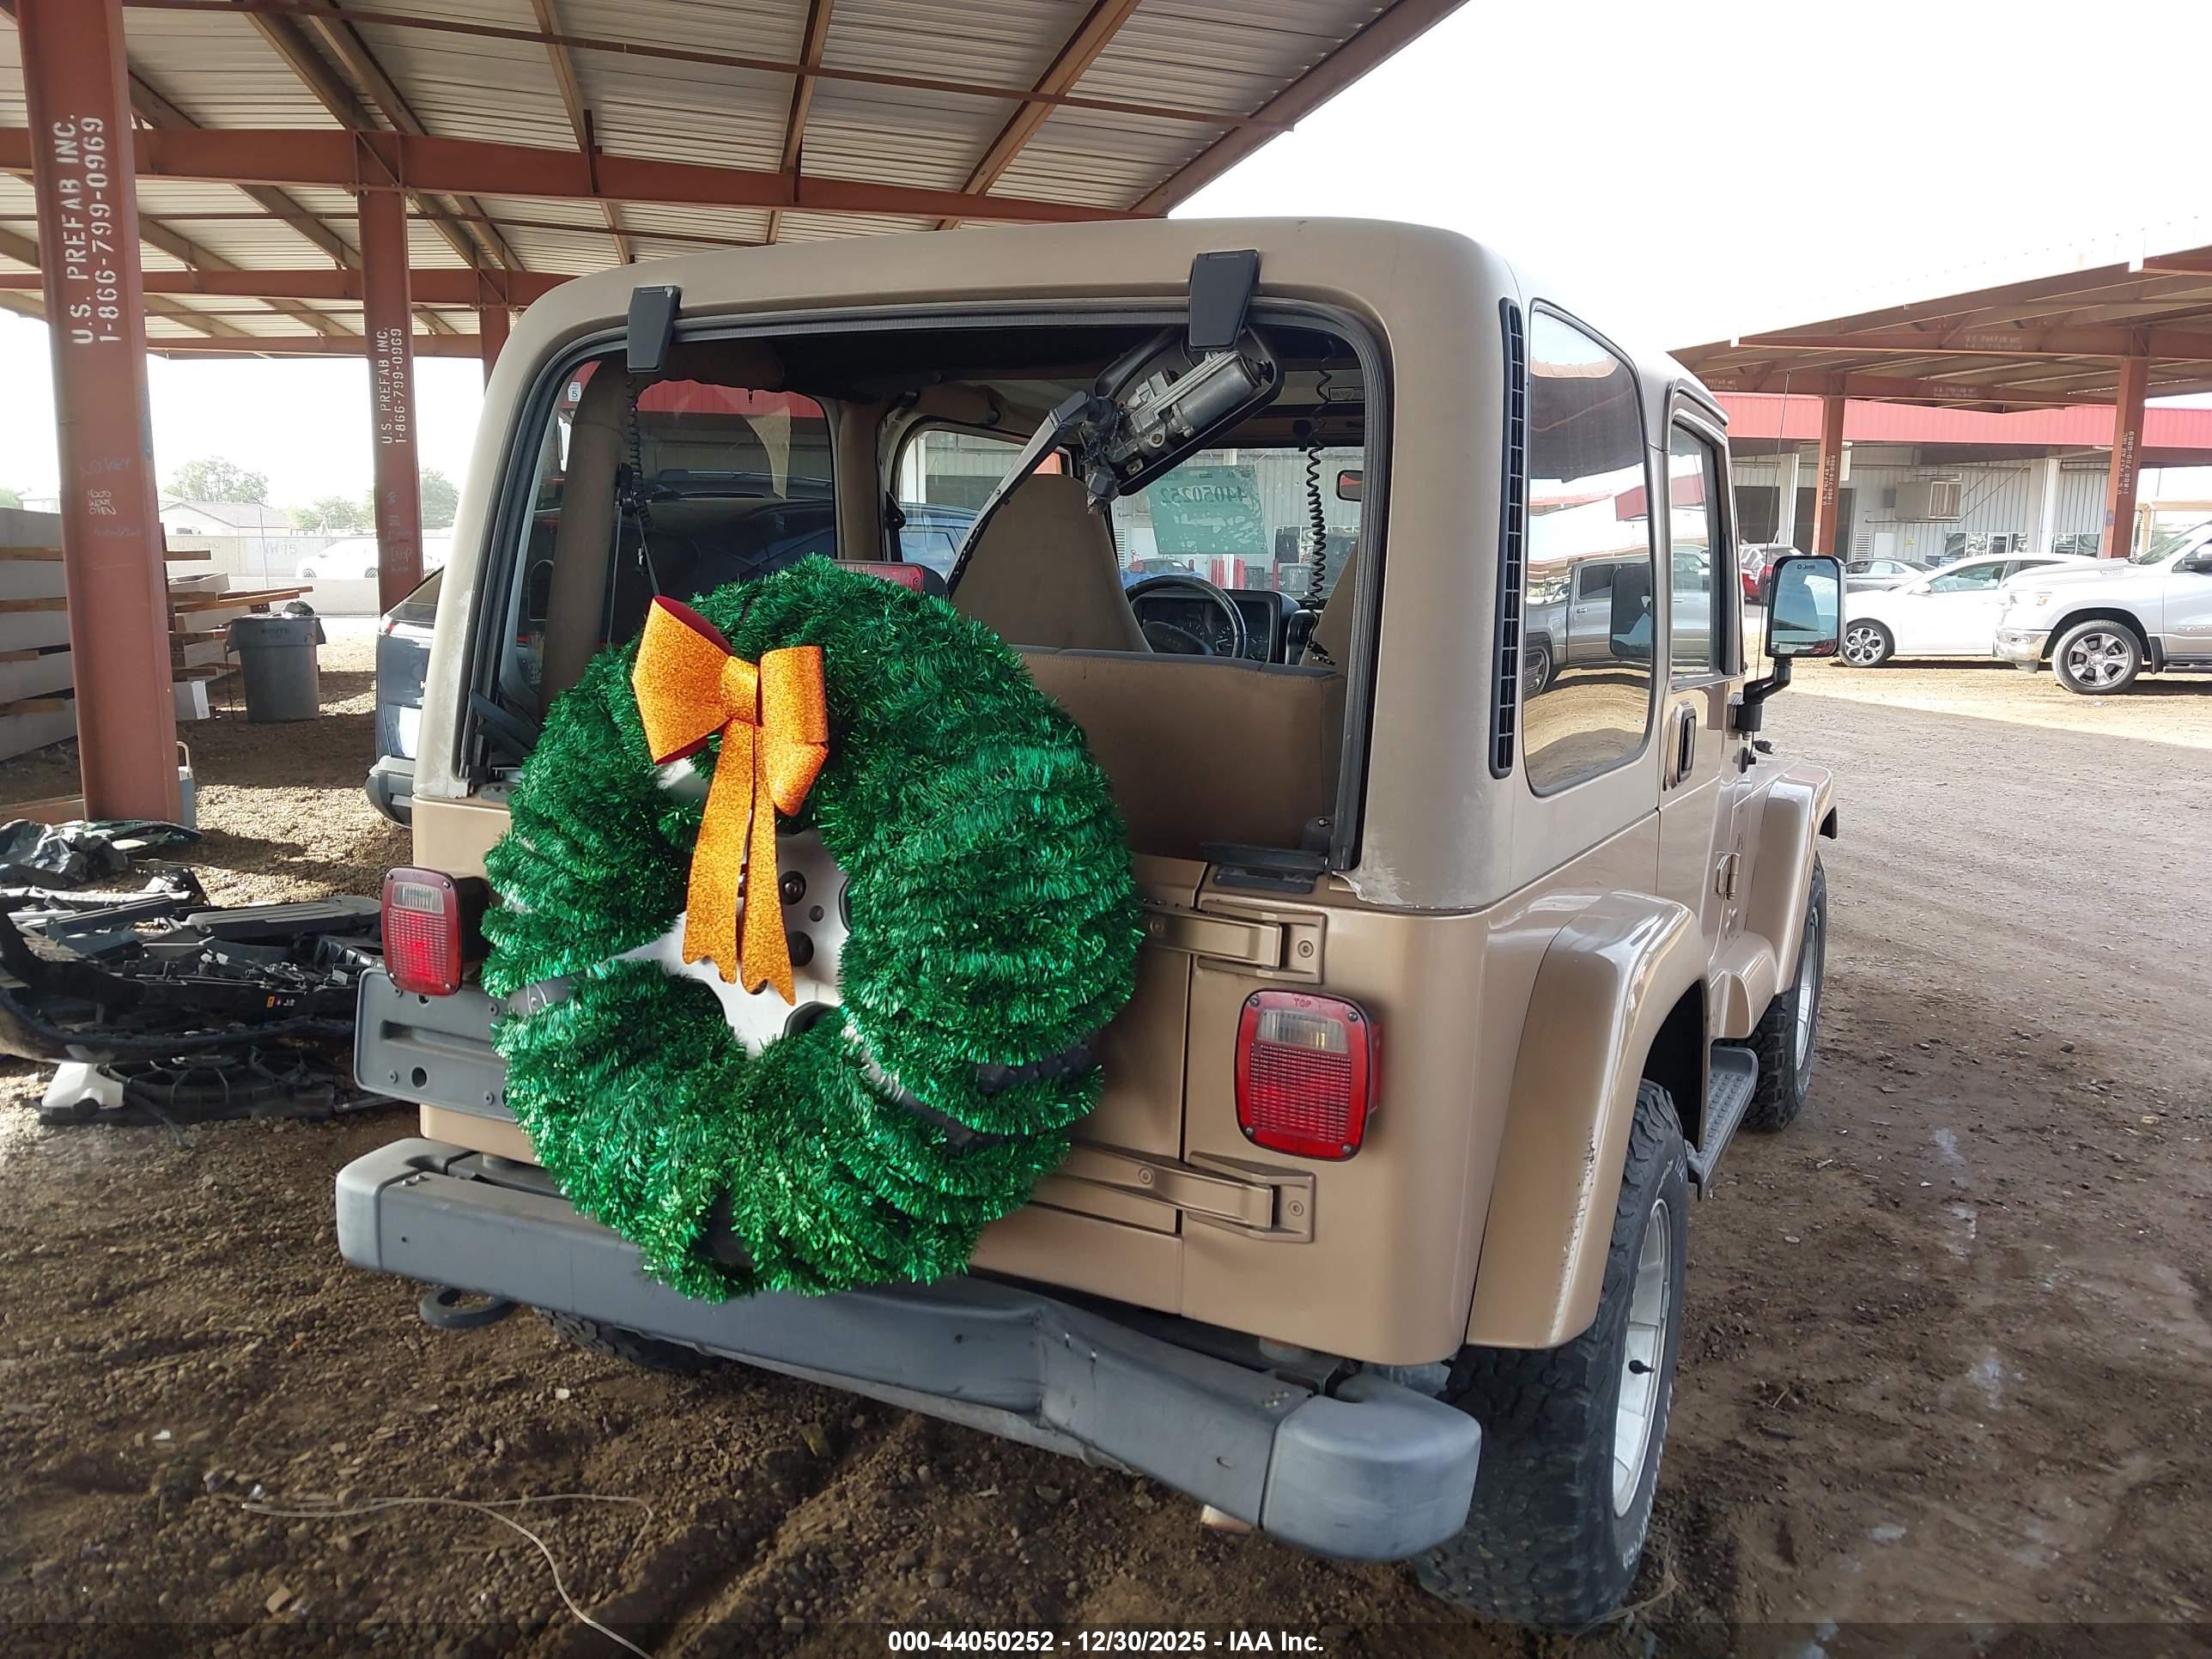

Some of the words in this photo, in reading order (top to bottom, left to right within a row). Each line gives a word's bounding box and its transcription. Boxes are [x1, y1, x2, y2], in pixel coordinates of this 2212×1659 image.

[52, 114, 80, 163] INC.
[58, 178, 89, 280] PREFAB
[81, 117, 122, 342] 1-866-799-0969
[70, 295, 94, 344] U.S.
[376, 326, 388, 352] INC.
[378, 358, 392, 412] PREFAB
[390, 328, 407, 443] 1-866-799-0969
[380, 418, 392, 445] U.S.
[1294, 998, 1312, 1008] TOP
